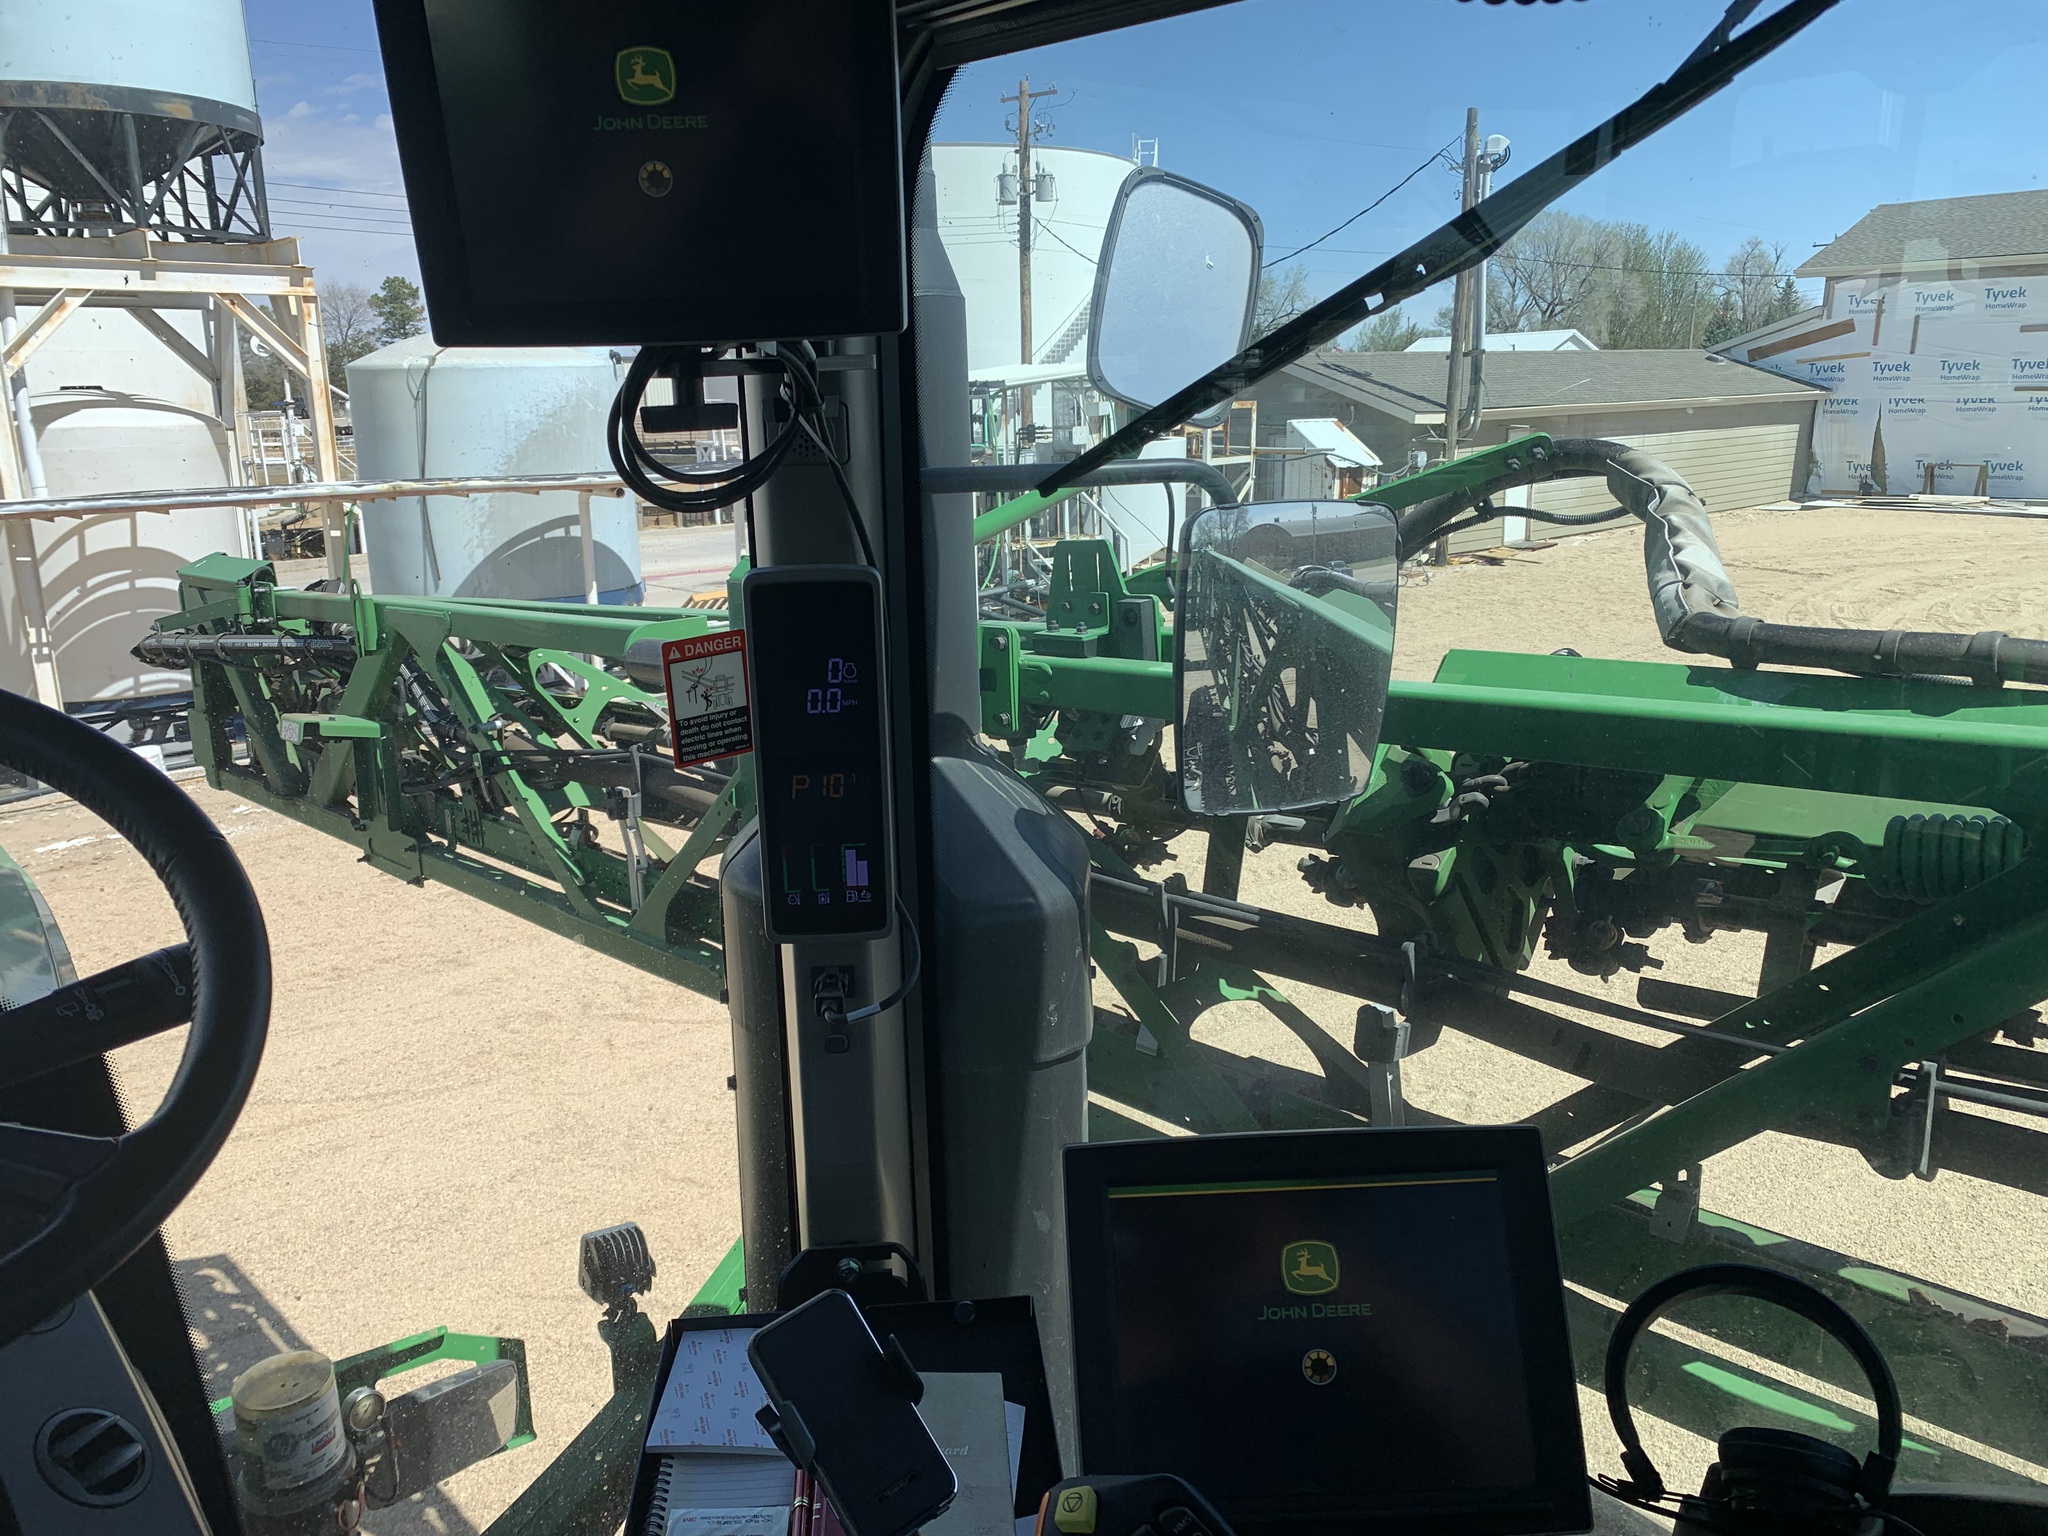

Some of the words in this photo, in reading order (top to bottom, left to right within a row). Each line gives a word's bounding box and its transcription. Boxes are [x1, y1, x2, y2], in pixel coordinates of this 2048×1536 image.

[592, 114, 643, 131] JOHN
[647, 113, 709, 129] DEERE
[1915, 290, 1954, 305] Tyvek
[1984, 286, 2027, 302] Tyvek
[1809, 362, 1845, 376] Tyvek
[1873, 361, 1911, 375] Tyvek
[1940, 360, 1980, 374] Tyvek
[2012, 358, 2048, 373] Tyve
[1888, 407, 1926, 415] HomeWrap
[685, 635, 742, 657] DANGER
[828, 658, 843, 684] 0
[807, 687, 842, 714] 0.0
[842, 699, 858, 707] MPH
[680, 726, 700, 736] death
[700, 724, 710, 732] do
[710, 721, 722, 729] not
[723, 716, 748, 726] contact
[690, 714, 708, 725] avoid
[681, 734, 706, 745] electric
[707, 730, 723, 739] lines
[724, 726, 742, 735] when
[682, 742, 708, 753] moving
[716, 733, 748, 745] operating
[683, 754, 696, 762] this
[697, 747, 727, 758] machine.
[791, 774, 810, 800] P
[1257, 1305, 1308, 1320] JOHN
[1311, 1303, 1372, 1318] DEERE
